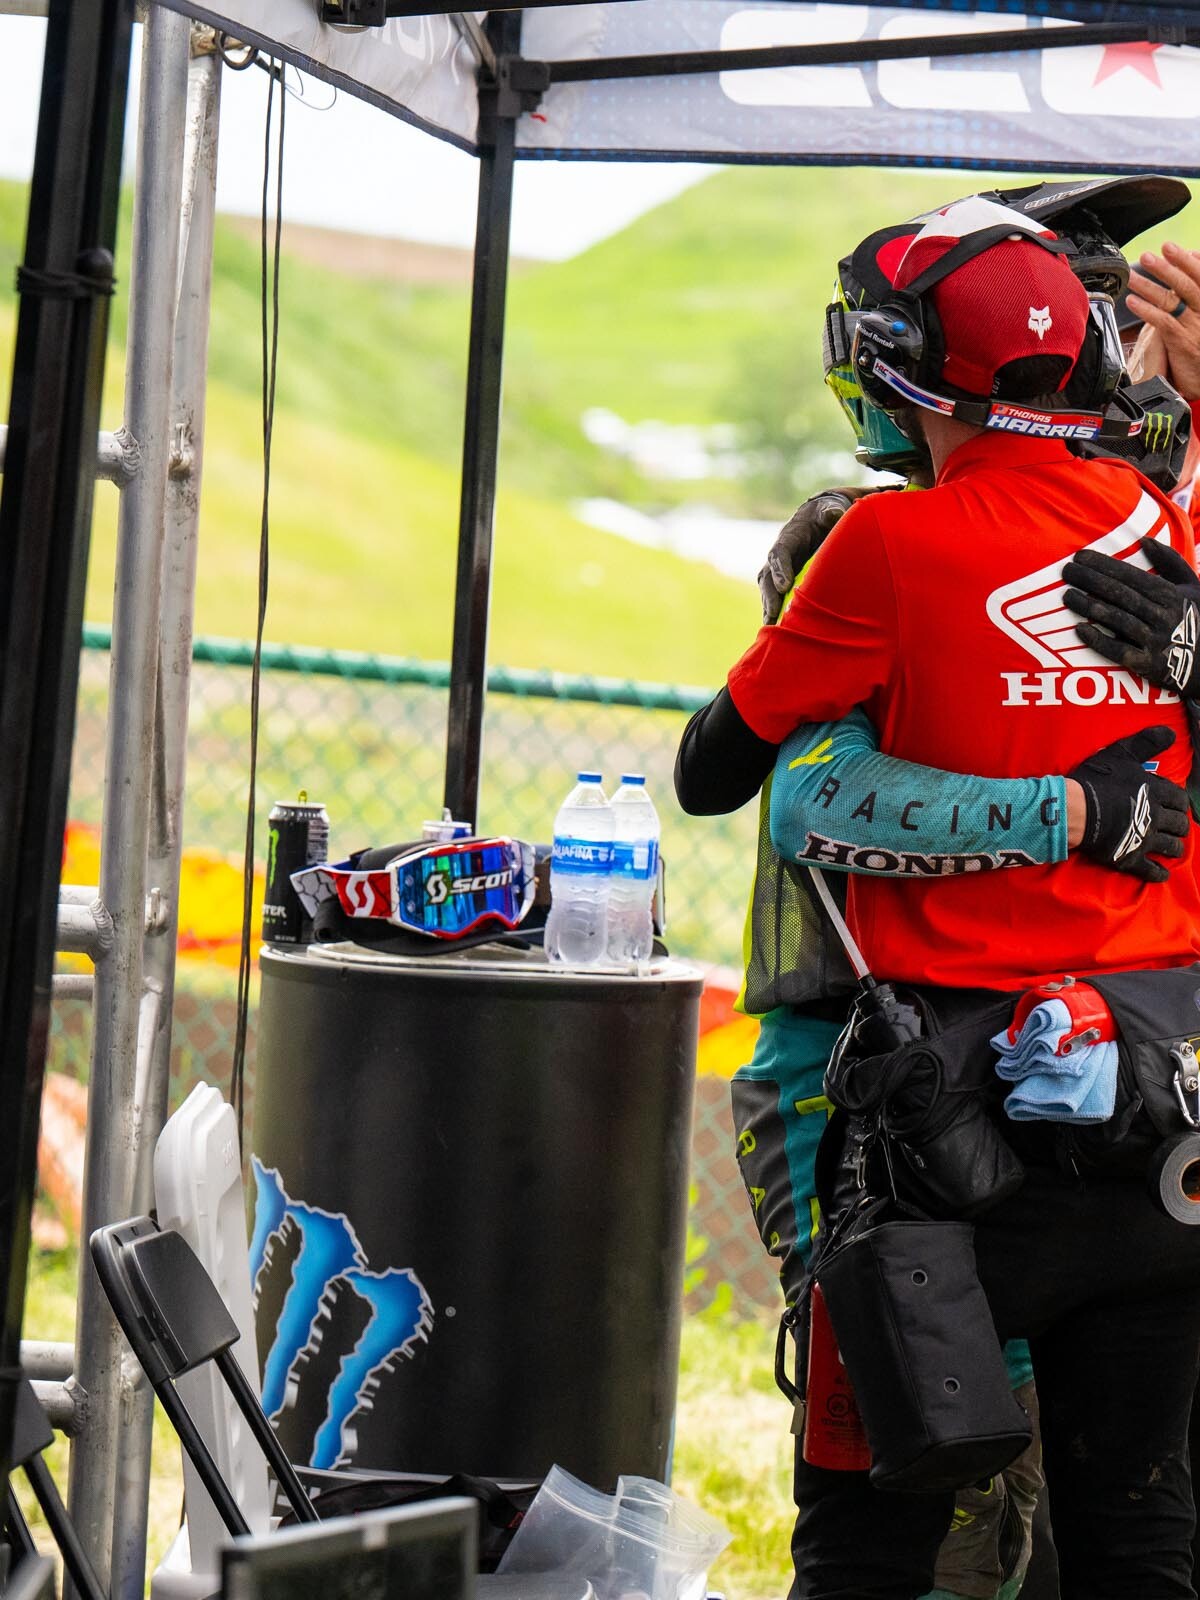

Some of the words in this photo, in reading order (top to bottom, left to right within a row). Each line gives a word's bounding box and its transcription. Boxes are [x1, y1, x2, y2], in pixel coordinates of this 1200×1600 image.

[985, 415, 1098, 439] HARRIS
[1008, 408, 1053, 423] THOMAS
[1000, 670, 1181, 706] HON
[812, 775, 1062, 834] RACING
[797, 832, 1042, 877] HONDA
